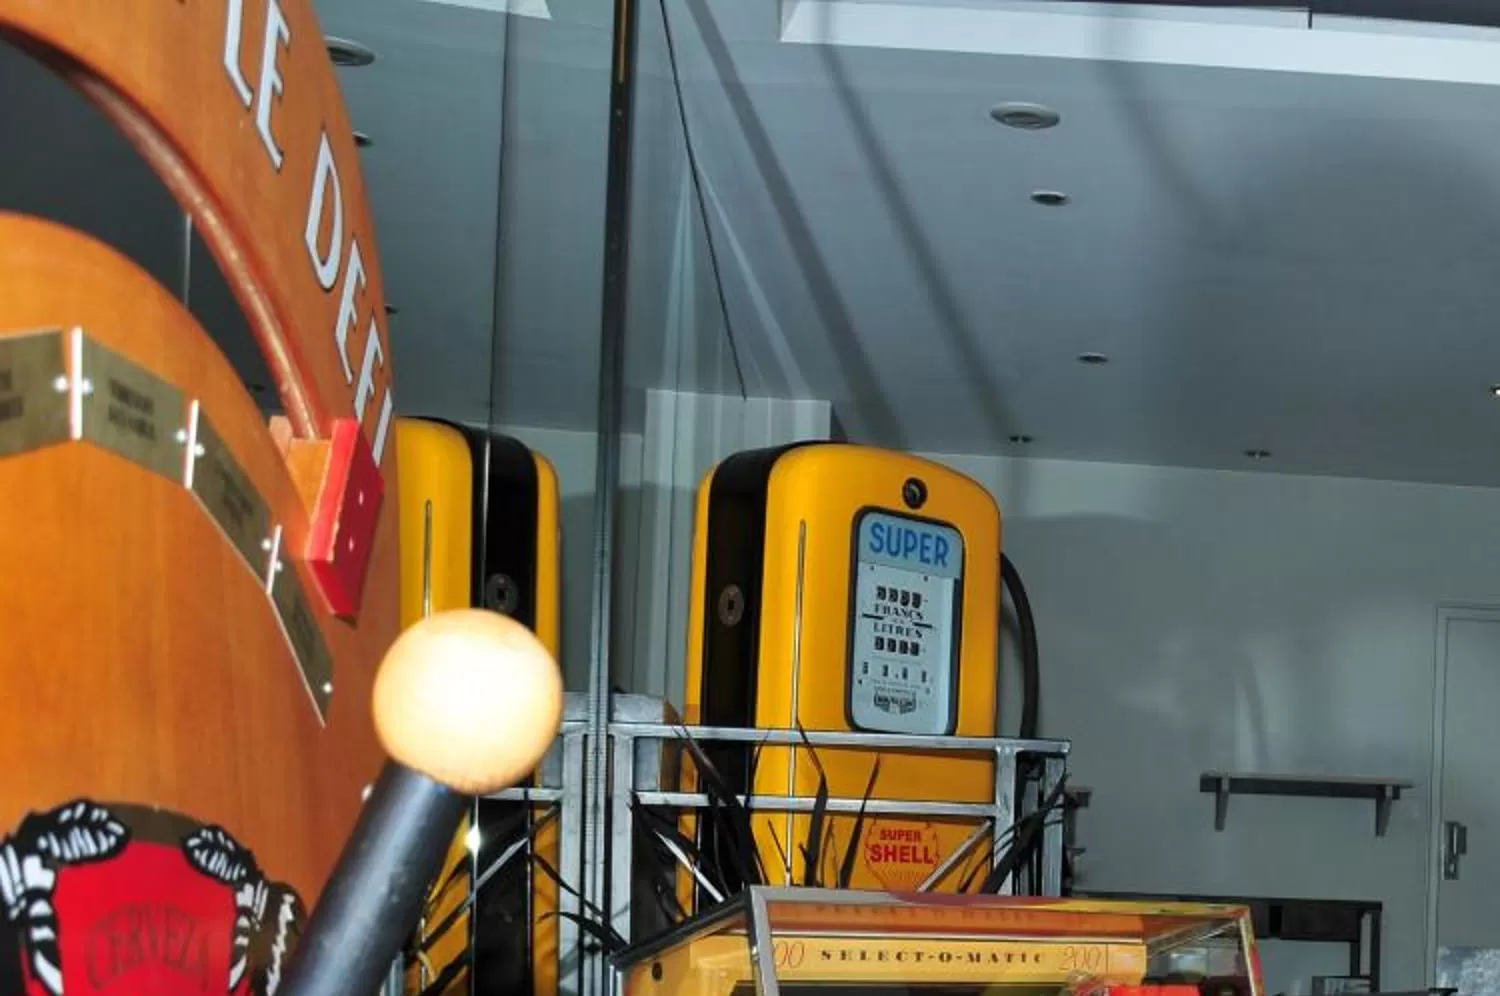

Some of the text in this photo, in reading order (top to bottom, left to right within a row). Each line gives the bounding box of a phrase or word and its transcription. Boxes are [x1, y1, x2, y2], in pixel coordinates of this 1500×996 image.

[869, 521, 949, 568] SUPER
[874, 603, 924, 620] FRANCS
[873, 621, 923, 639] LITRES
[880, 829, 921, 842] SUPER
[870, 843, 934, 865] SHELL
[820, 950, 1043, 965] SELECT-O-MATIC
